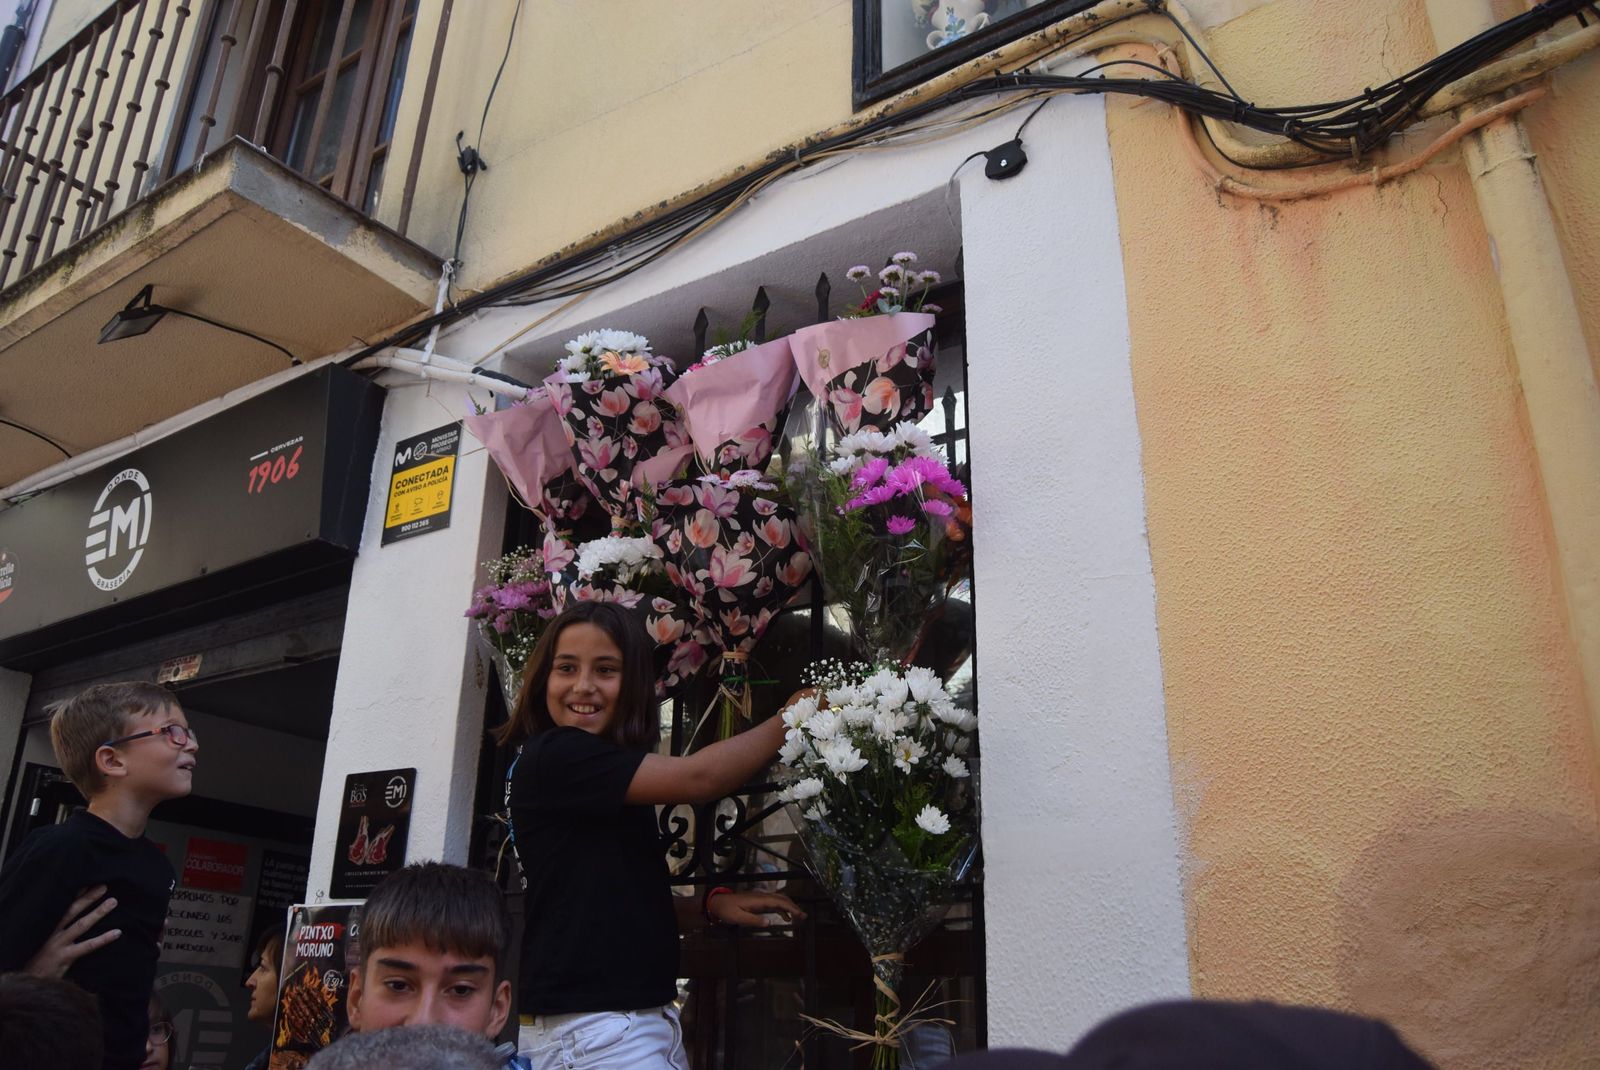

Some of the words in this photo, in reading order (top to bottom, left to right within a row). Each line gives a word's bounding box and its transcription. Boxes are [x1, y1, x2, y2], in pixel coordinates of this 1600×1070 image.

[270, 435, 304, 453] CERVEZAS
[430, 436, 459, 450] PROSEGUR
[432, 430, 458, 443] MOVISTAR
[247, 445, 303, 494] 1906
[106, 469, 140, 492] DONDE
[395, 465, 449, 490] CONECTADA
[393, 488, 406, 498] CON
[406, 484, 423, 494] AVISO
[299, 925, 334, 940] PINTXO
[295, 942, 334, 957] MORUNO
